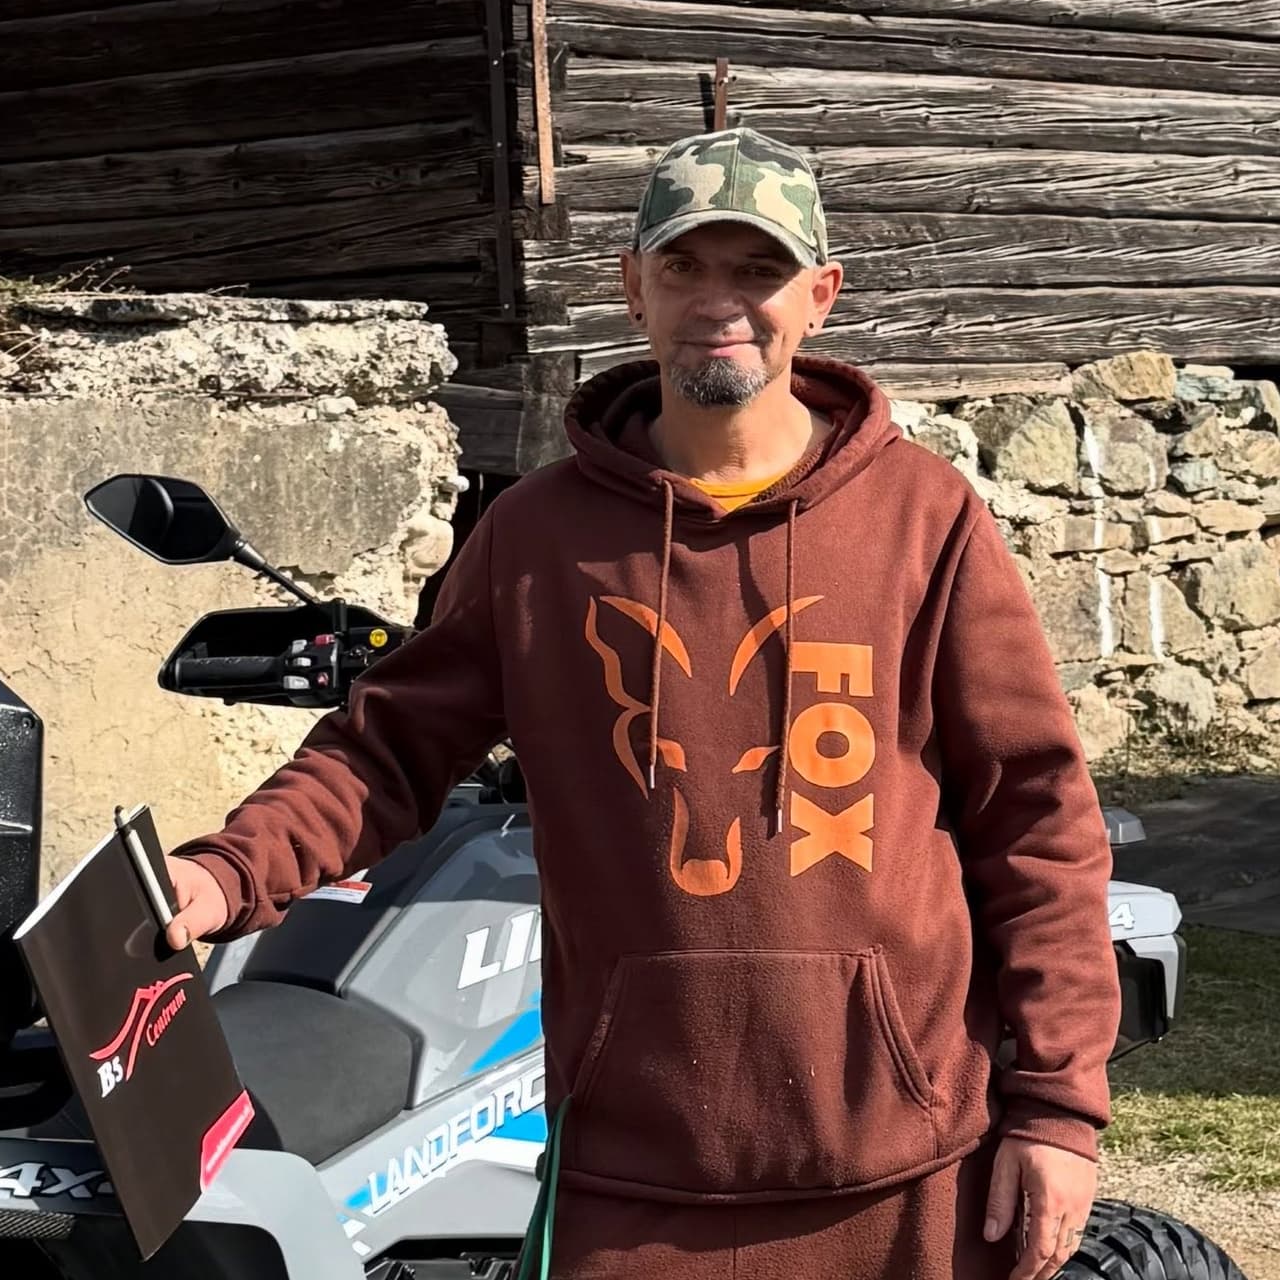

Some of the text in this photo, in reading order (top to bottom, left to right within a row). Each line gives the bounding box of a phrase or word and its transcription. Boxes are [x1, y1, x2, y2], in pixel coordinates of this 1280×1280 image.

[787, 640, 876, 877] FOX
[146, 988, 187, 1047] Centrum
[97, 1056, 124, 1098] B5
[368, 1065, 546, 1216] LANDFORC
